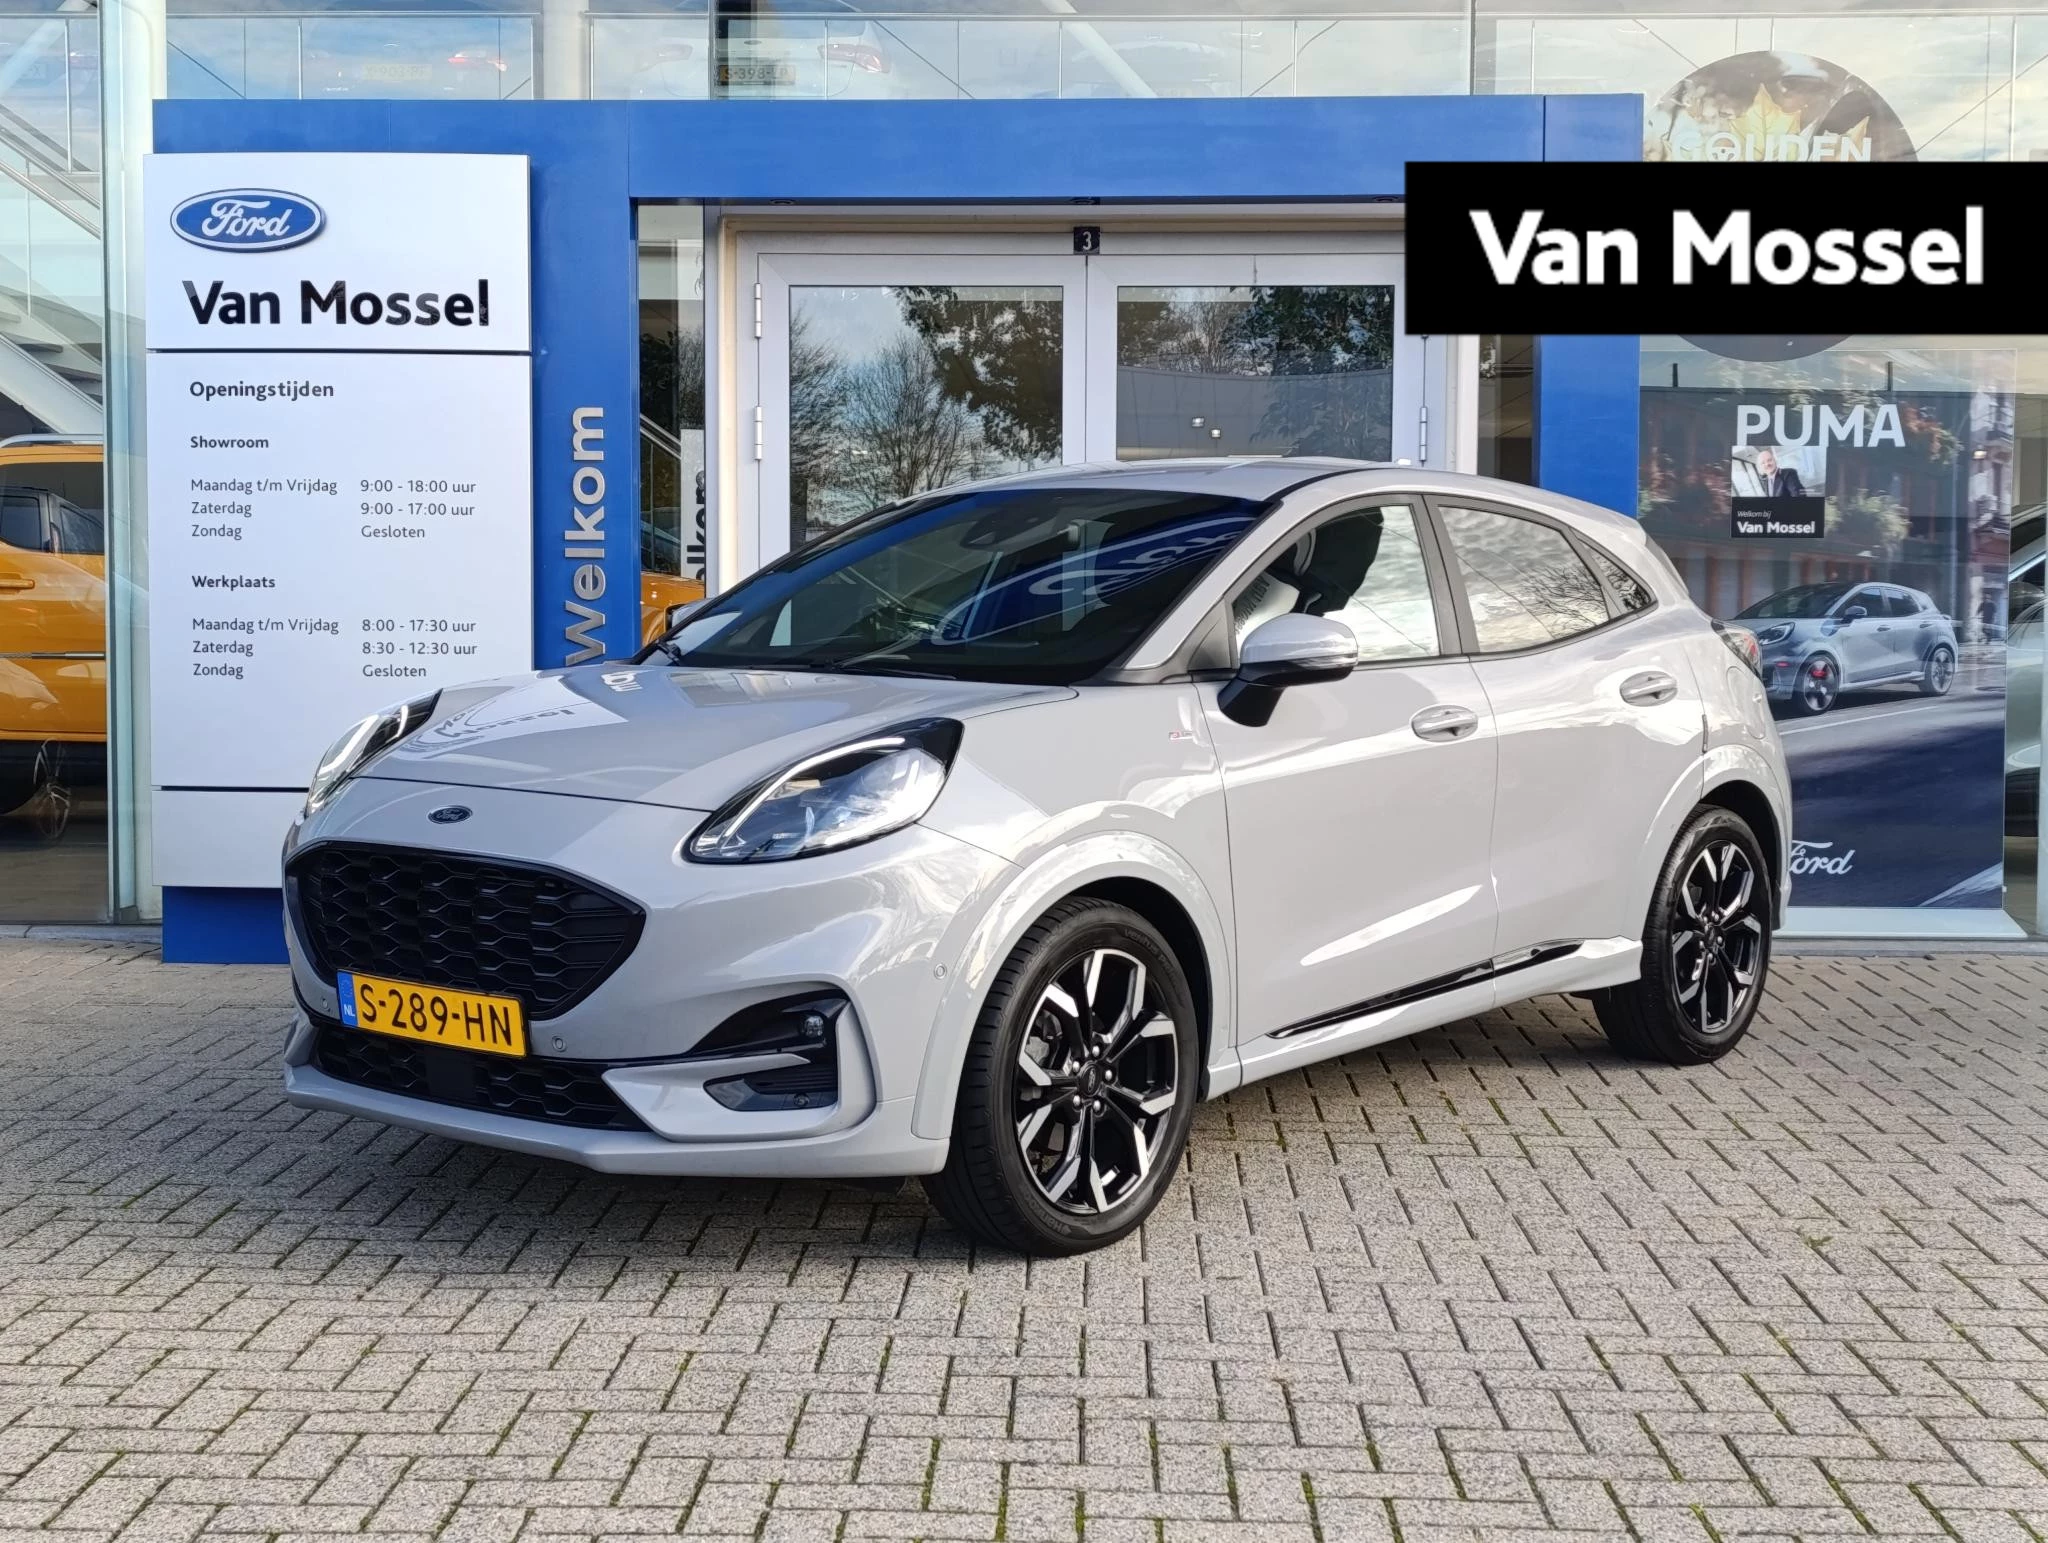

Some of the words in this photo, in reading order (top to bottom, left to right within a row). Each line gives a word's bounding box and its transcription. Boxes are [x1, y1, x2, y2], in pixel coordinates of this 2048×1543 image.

[201, 198, 291, 237] Ford
[1082, 231, 1092, 251] 3
[182, 280, 280, 325] Van
[300, 279, 489, 327] Mossel
[189, 380, 334, 402] Openingstijden
[1736, 404, 1906, 447] PUMA
[190, 435, 269, 449] Showroom
[191, 479, 253, 495] Maandag
[257, 479, 282, 492] t/m
[287, 479, 338, 496] Vrijdag
[360, 480, 393, 493] 9:00
[407, 480, 448, 493] 18:00
[452, 482, 477, 493] uur
[191, 501, 253, 518] Zaterdag
[360, 502, 393, 515] 9:00
[407, 502, 447, 516] 17:00
[450, 505, 475, 516] uur
[191, 524, 243, 540] Zondag
[361, 525, 426, 538] Gesloten
[1737, 521, 1763, 534] Van
[1767, 521, 1815, 534] Mossel
[565, 407, 605, 667] Welkom
[192, 575, 276, 591] Werkplaats
[192, 618, 254, 634] Maandag
[258, 618, 284, 631] t/m
[288, 618, 339, 635] Vrijdag
[362, 619, 395, 632] 8:00
[408, 619, 448, 632] 17:30
[452, 621, 476, 632] uur
[192, 641, 254, 657] Zaterdag
[362, 642, 395, 655] 8:30
[408, 642, 449, 655] 12:30
[453, 644, 477, 655] uur
[192, 663, 244, 679] Zondag
[362, 664, 427, 677] Gesloten
[343, 1002, 356, 1018] NL
[360, 983, 512, 1046] S-289-HN
